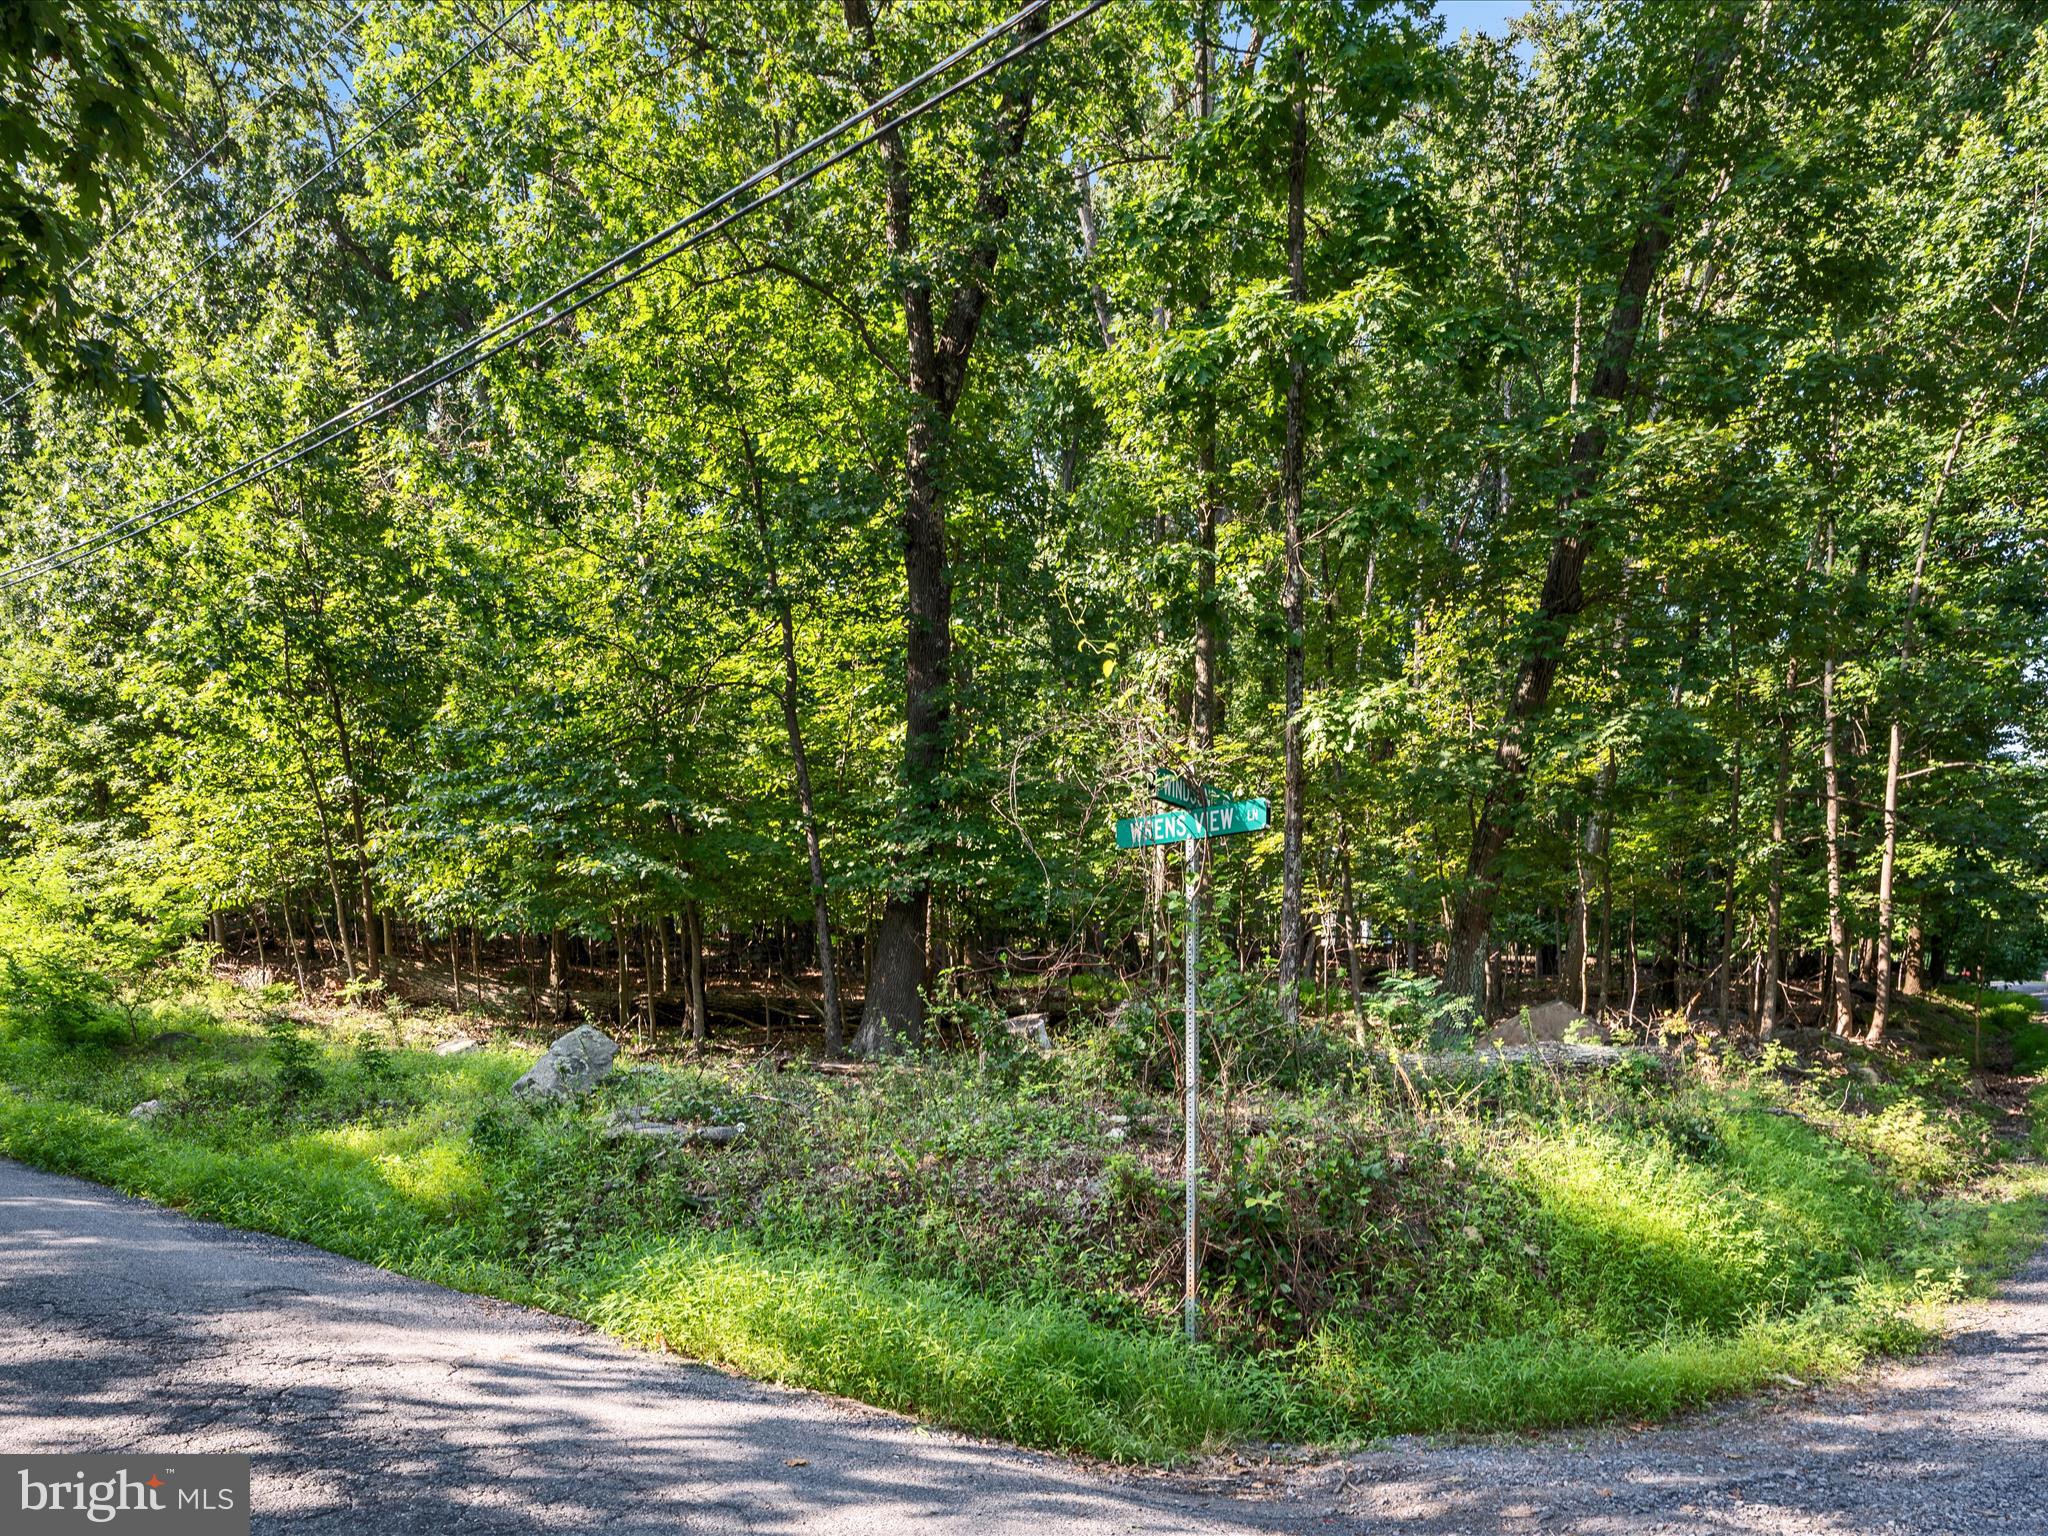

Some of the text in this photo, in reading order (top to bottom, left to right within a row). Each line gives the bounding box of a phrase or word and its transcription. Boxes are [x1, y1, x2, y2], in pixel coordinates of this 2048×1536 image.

[1130, 808, 1259, 847] WRENS VIEW LN
